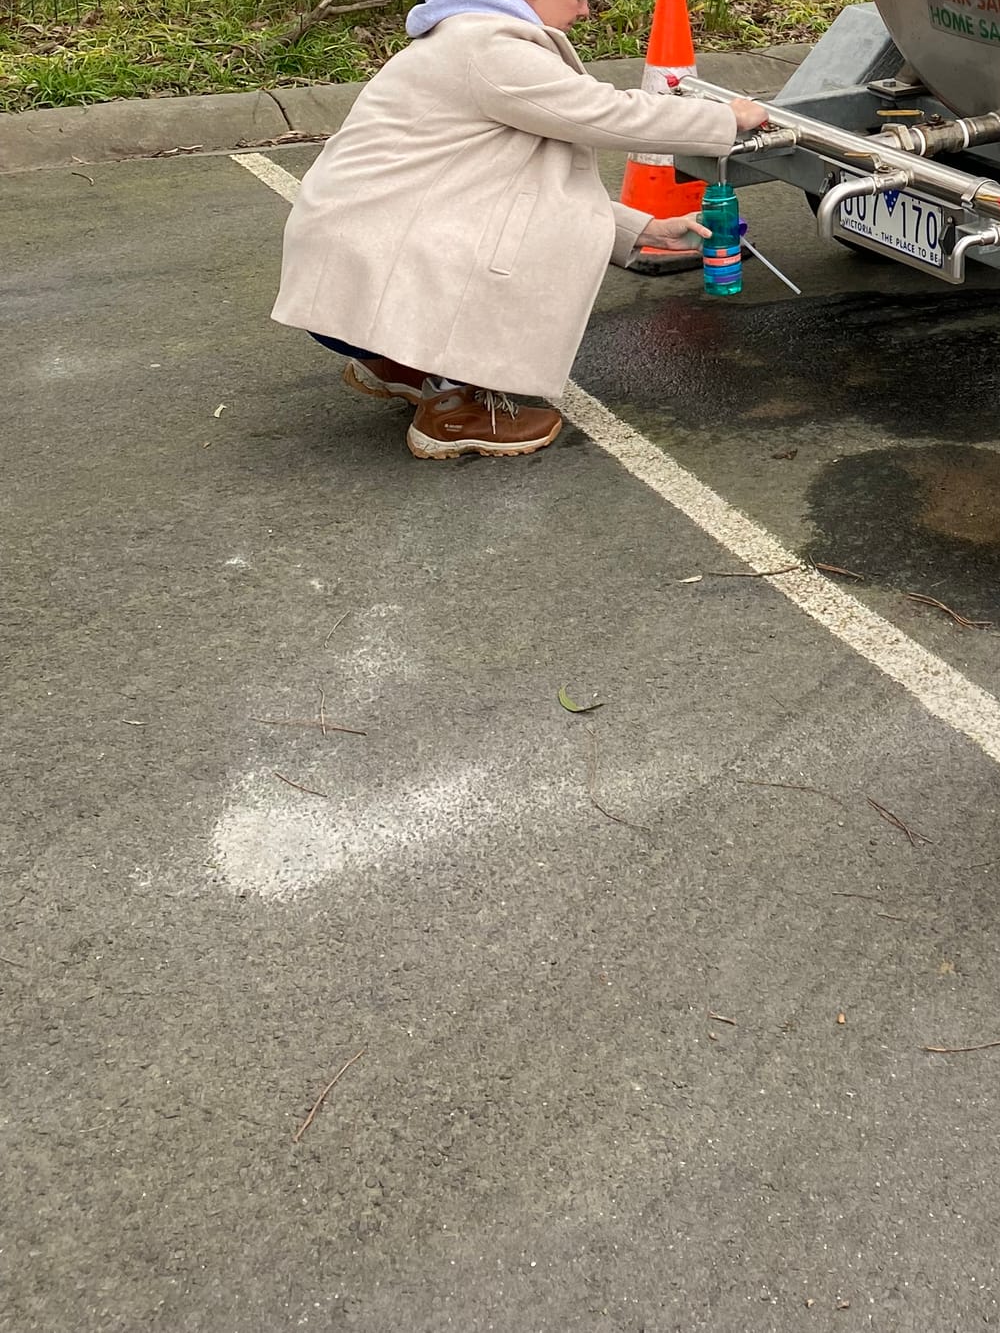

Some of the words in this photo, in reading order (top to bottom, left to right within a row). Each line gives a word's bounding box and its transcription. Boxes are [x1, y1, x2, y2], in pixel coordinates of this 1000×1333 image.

[929, 6, 974, 36] HOME
[843, 217, 873, 236] VICTORIA
[881, 232, 893, 244] THE
[896, 238, 915, 254] PLACE
[918, 247, 926, 258] TO
[930, 252, 938, 263] BE
[901, 201, 938, 250] 170
